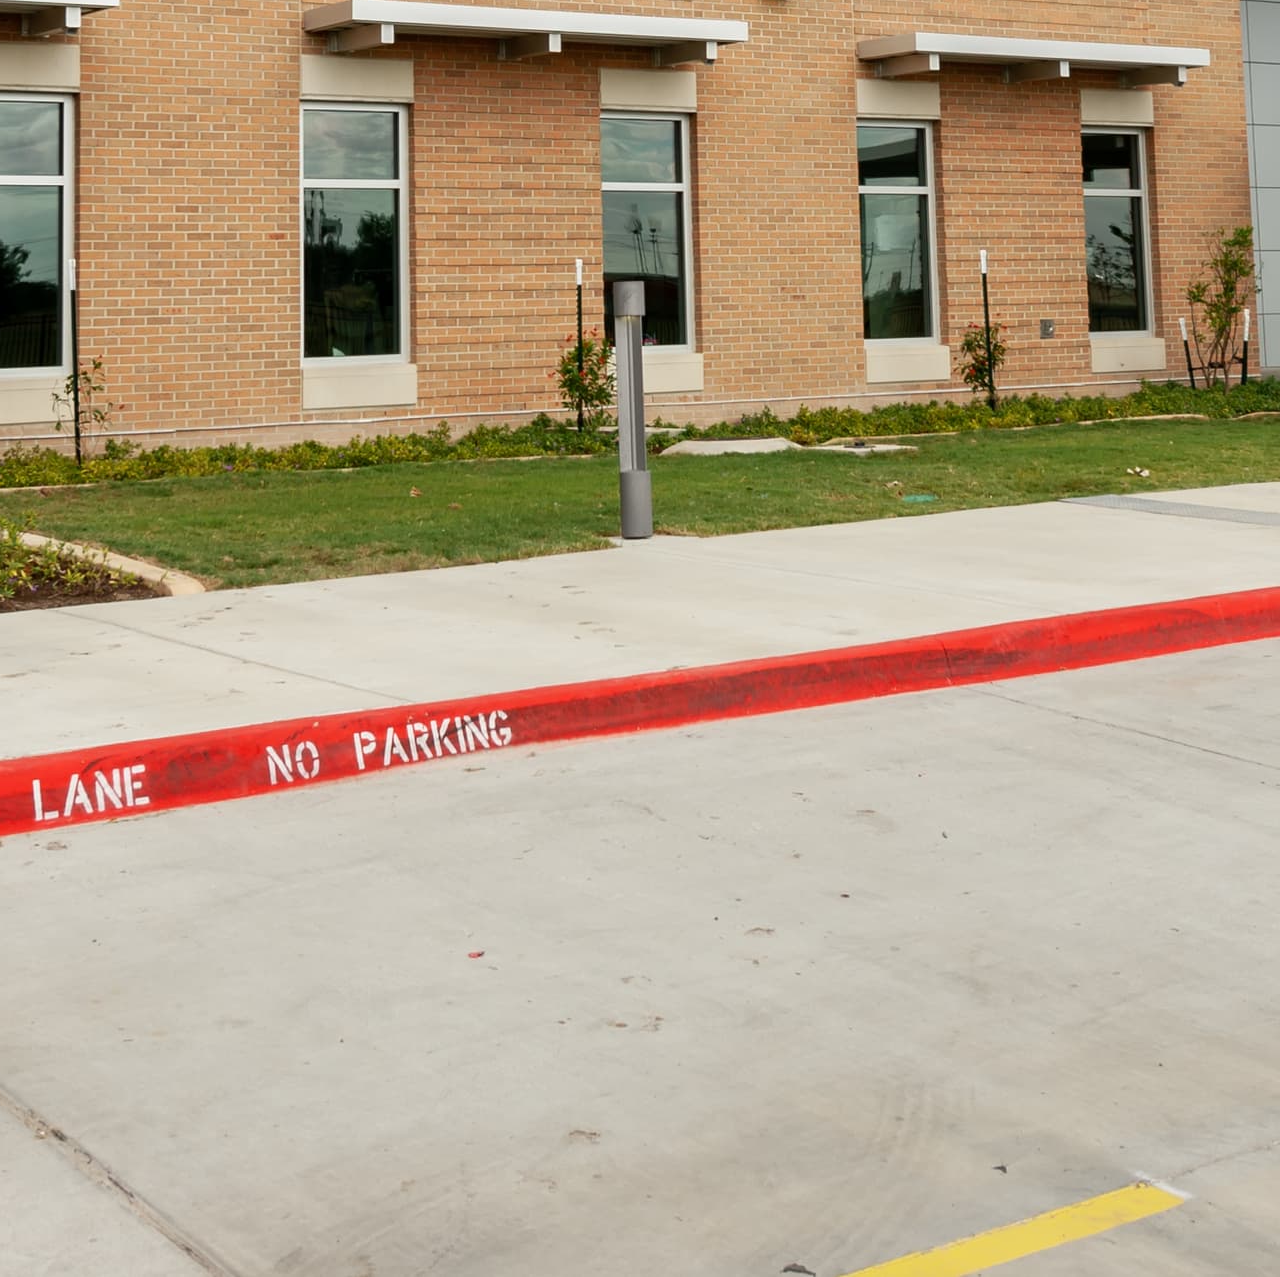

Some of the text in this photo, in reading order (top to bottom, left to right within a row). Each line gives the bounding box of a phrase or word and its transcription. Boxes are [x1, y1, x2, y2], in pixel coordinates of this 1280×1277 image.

[31, 764, 150, 821] LANE
[265, 740, 320, 785] NO
[353, 709, 513, 770] PARKING
